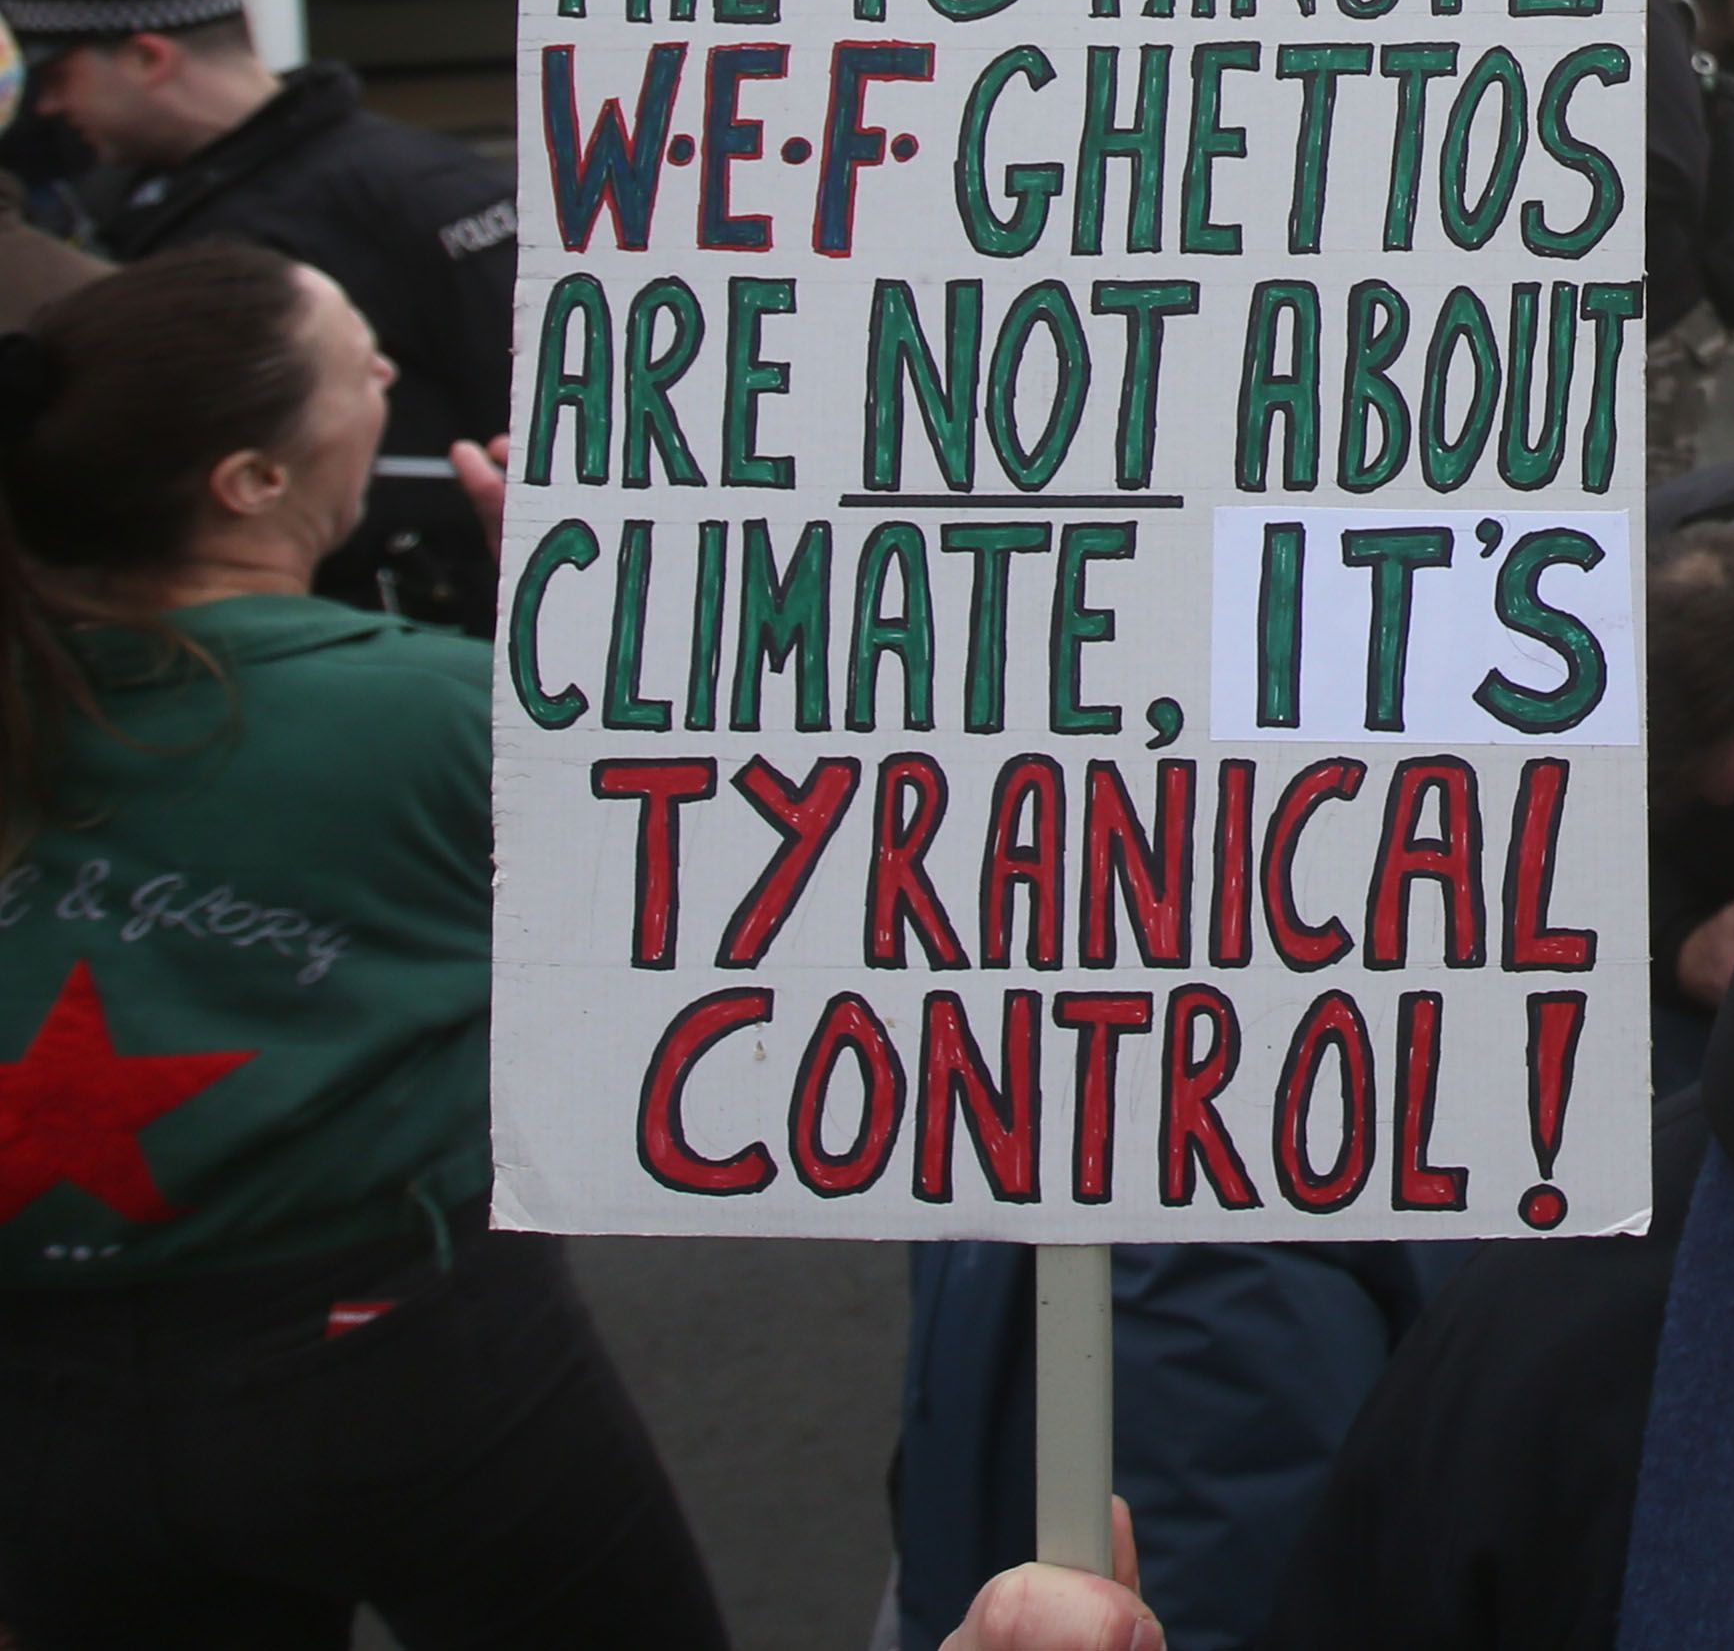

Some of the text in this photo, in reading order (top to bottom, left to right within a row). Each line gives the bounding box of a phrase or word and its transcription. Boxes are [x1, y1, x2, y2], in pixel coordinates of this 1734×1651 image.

[954, 44, 1630, 257] GHETTOS
[525, 274, 1643, 493] ARE NOT ABOUT
[508, 518, 1607, 749] CLIMATE, IT'S
[55, 858, 111, 921] &
[592, 752, 1598, 970] TYRANICAL
[637, 986, 1586, 1230] CONTROL!
